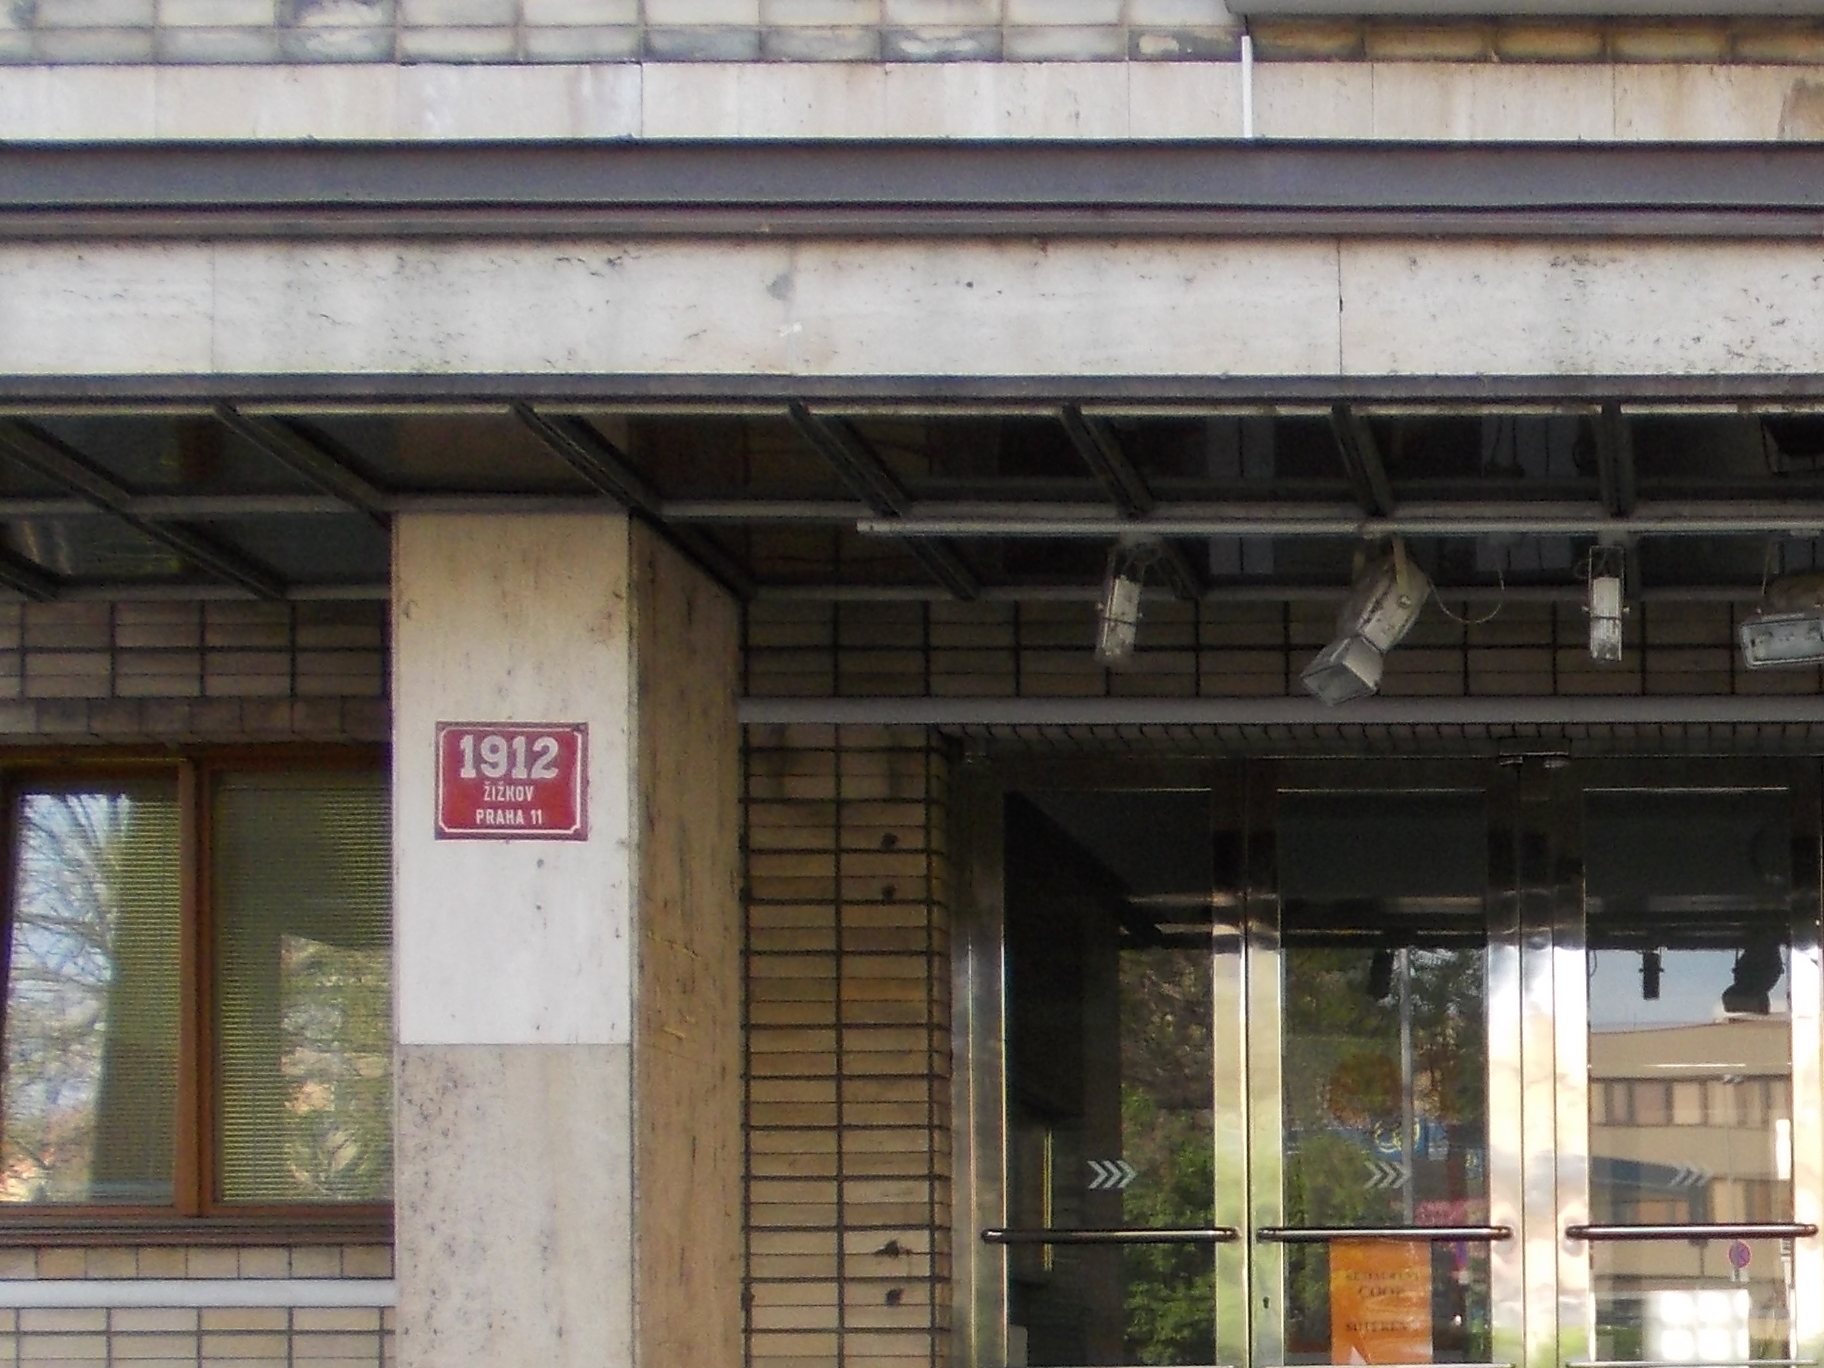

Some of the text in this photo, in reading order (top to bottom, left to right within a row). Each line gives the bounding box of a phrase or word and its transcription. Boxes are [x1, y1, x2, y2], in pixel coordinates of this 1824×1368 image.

[460, 734, 559, 779] 1912
[484, 781, 534, 801] ŽIŽKOV
[476, 809, 542, 825] PRAHA 11
